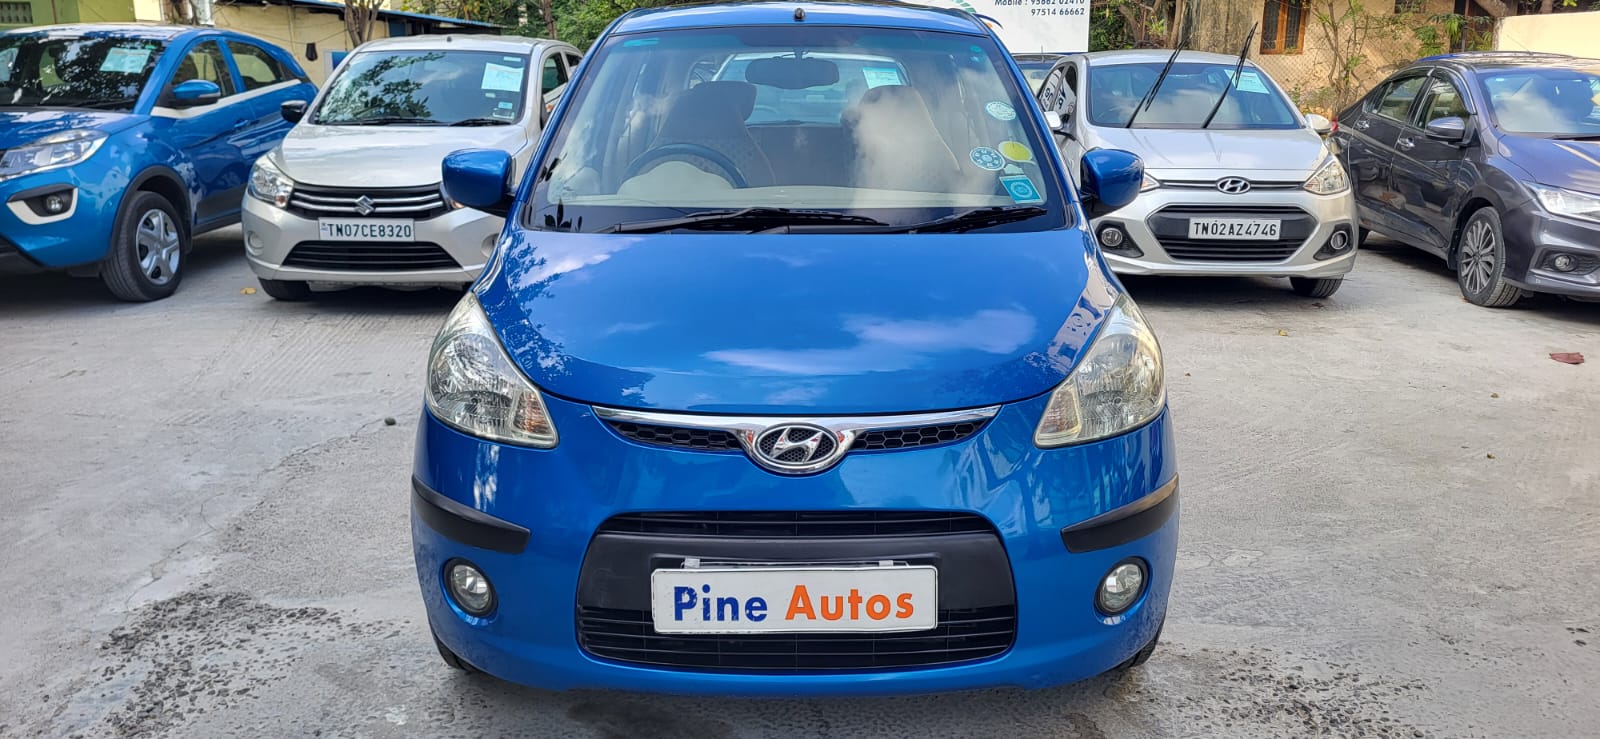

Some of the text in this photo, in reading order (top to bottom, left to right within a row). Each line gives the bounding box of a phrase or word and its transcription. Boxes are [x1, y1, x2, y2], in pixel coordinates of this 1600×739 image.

[1031, 7, 1085, 16] 97514 66662
[327, 223, 412, 238] TN07CE8320
[1194, 222, 1277, 236] TN02AZ4746
[673, 583, 915, 622] Pine Autos
